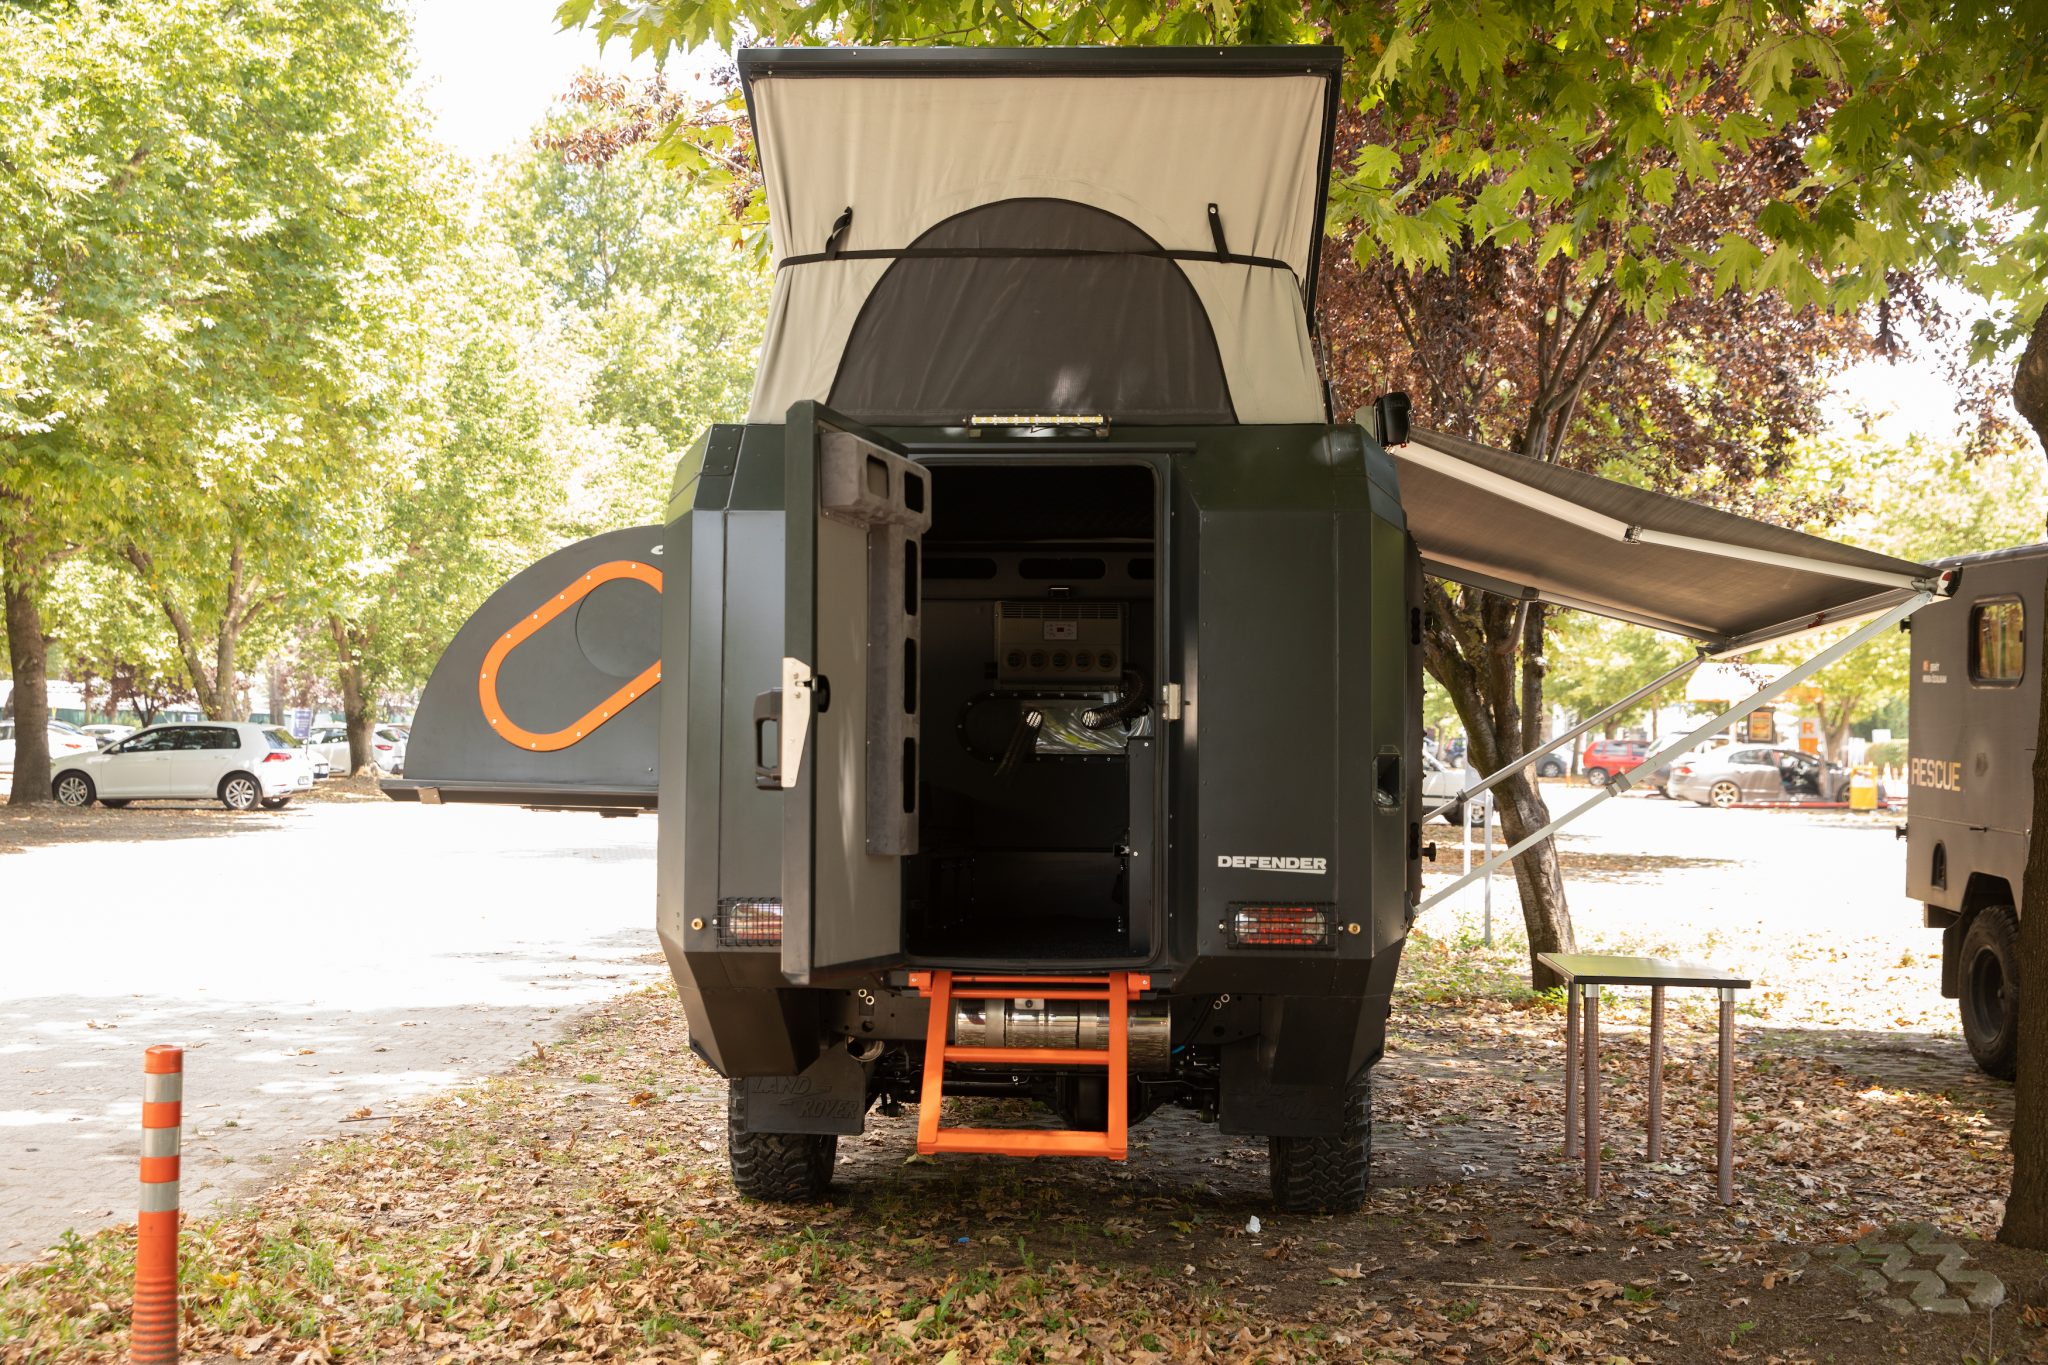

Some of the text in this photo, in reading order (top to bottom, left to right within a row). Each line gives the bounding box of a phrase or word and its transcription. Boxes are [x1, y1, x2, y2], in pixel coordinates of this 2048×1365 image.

[1911, 758, 1961, 792] RESCUE
[1217, 856, 1327, 870] DEFENDER
[752, 1076, 812, 1095] LAND
[799, 1099, 860, 1119] ROVER
